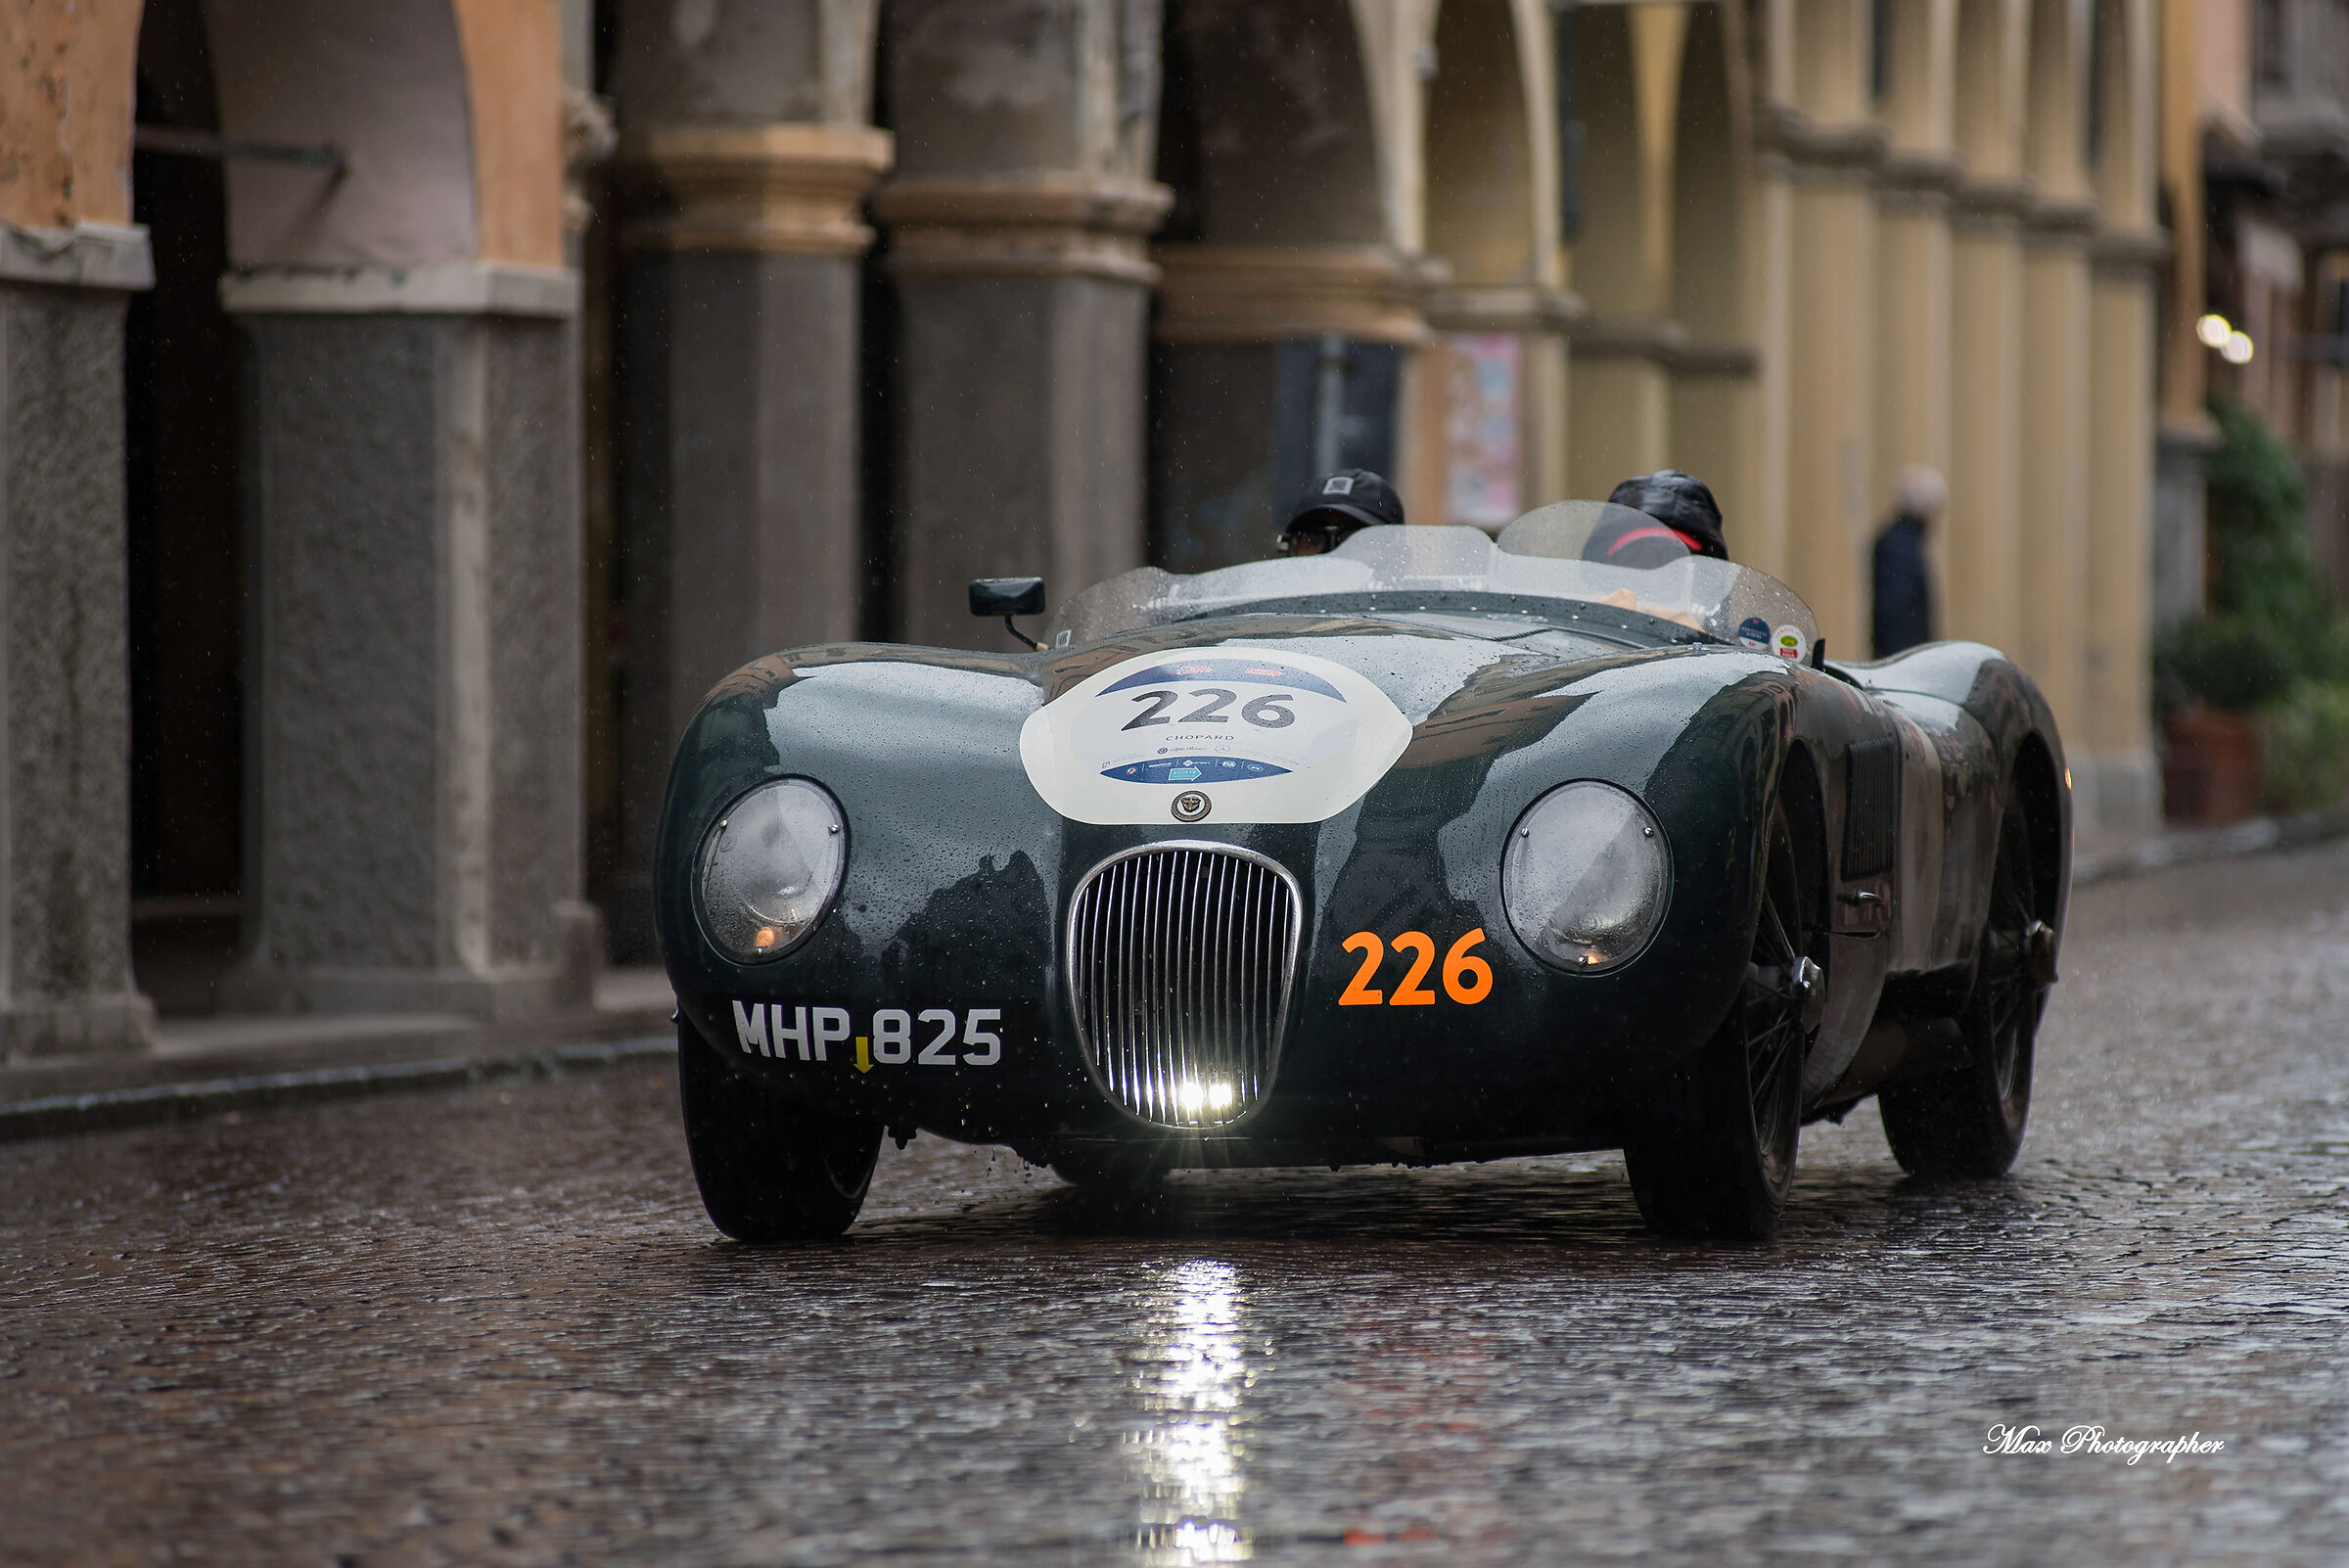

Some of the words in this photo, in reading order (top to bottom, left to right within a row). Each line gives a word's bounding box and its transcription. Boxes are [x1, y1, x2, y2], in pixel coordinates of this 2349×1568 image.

[1121, 688, 1296, 731] 226
[1338, 927, 1494, 1006] 226
[732, 999, 851, 1062] MHP
[872, 1008, 1001, 1066] 825
